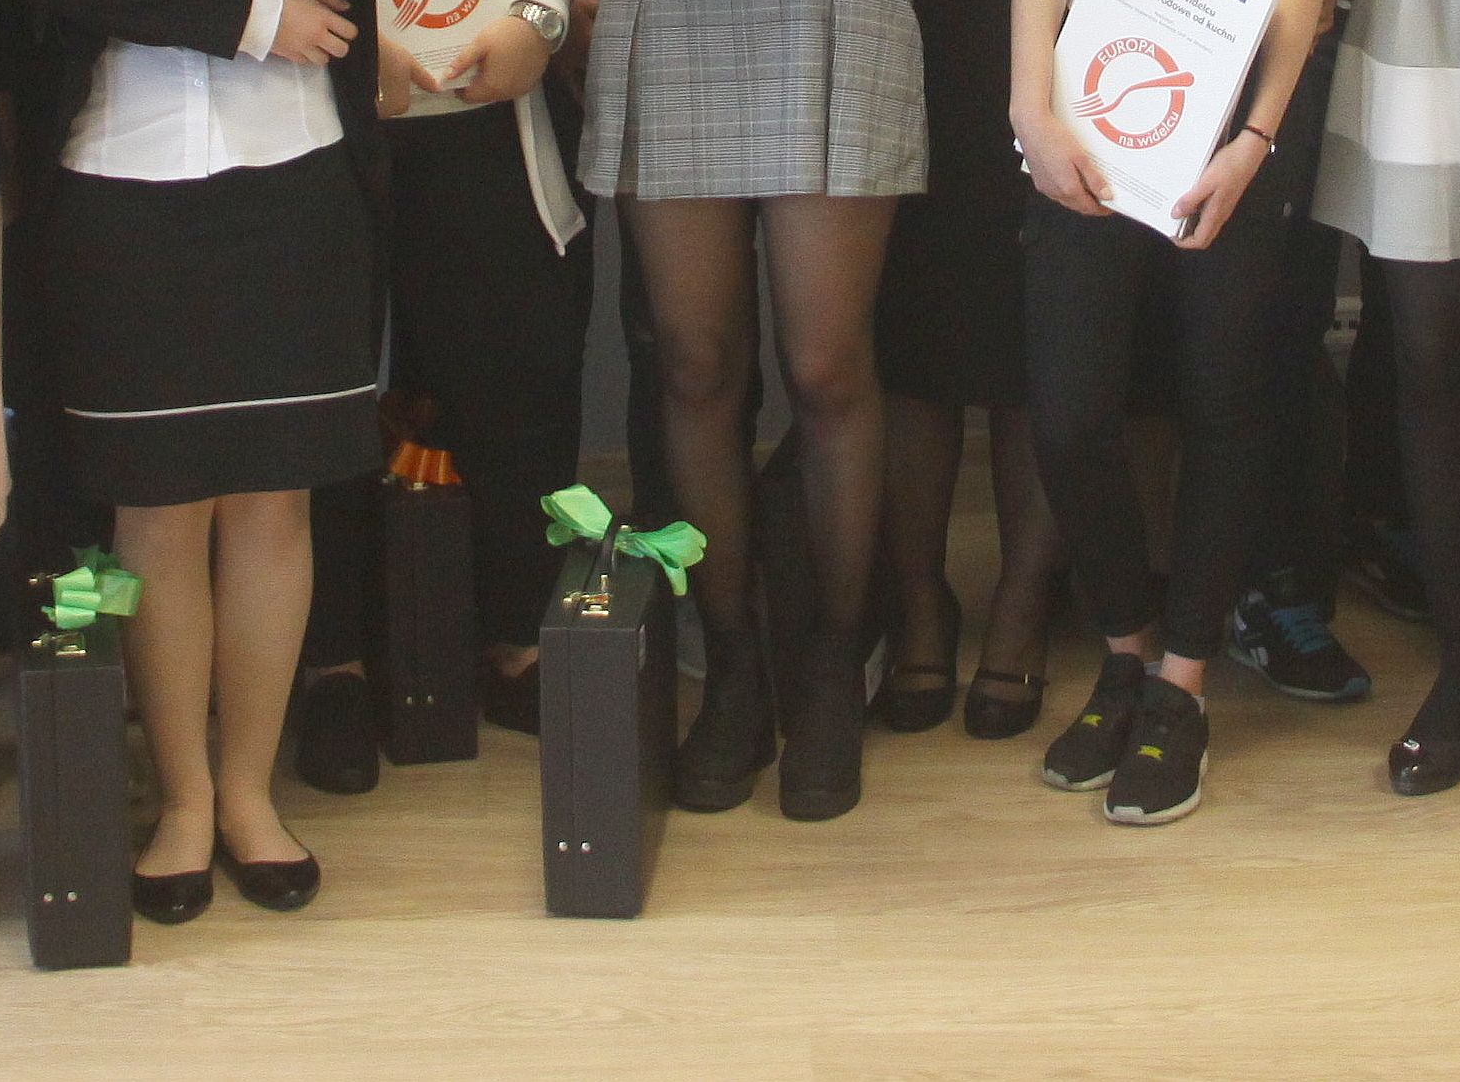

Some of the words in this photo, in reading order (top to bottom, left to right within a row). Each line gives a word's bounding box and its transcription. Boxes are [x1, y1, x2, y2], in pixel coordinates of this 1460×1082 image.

[445, 11, 461, 25] na
[1192, 13, 1206, 26] od
[1206, 19, 1237, 44] kuchni
[1097, 38, 1156, 65] EUROPA
[1118, 135, 1134, 147] na
[1136, 110, 1180, 148] widelcu
